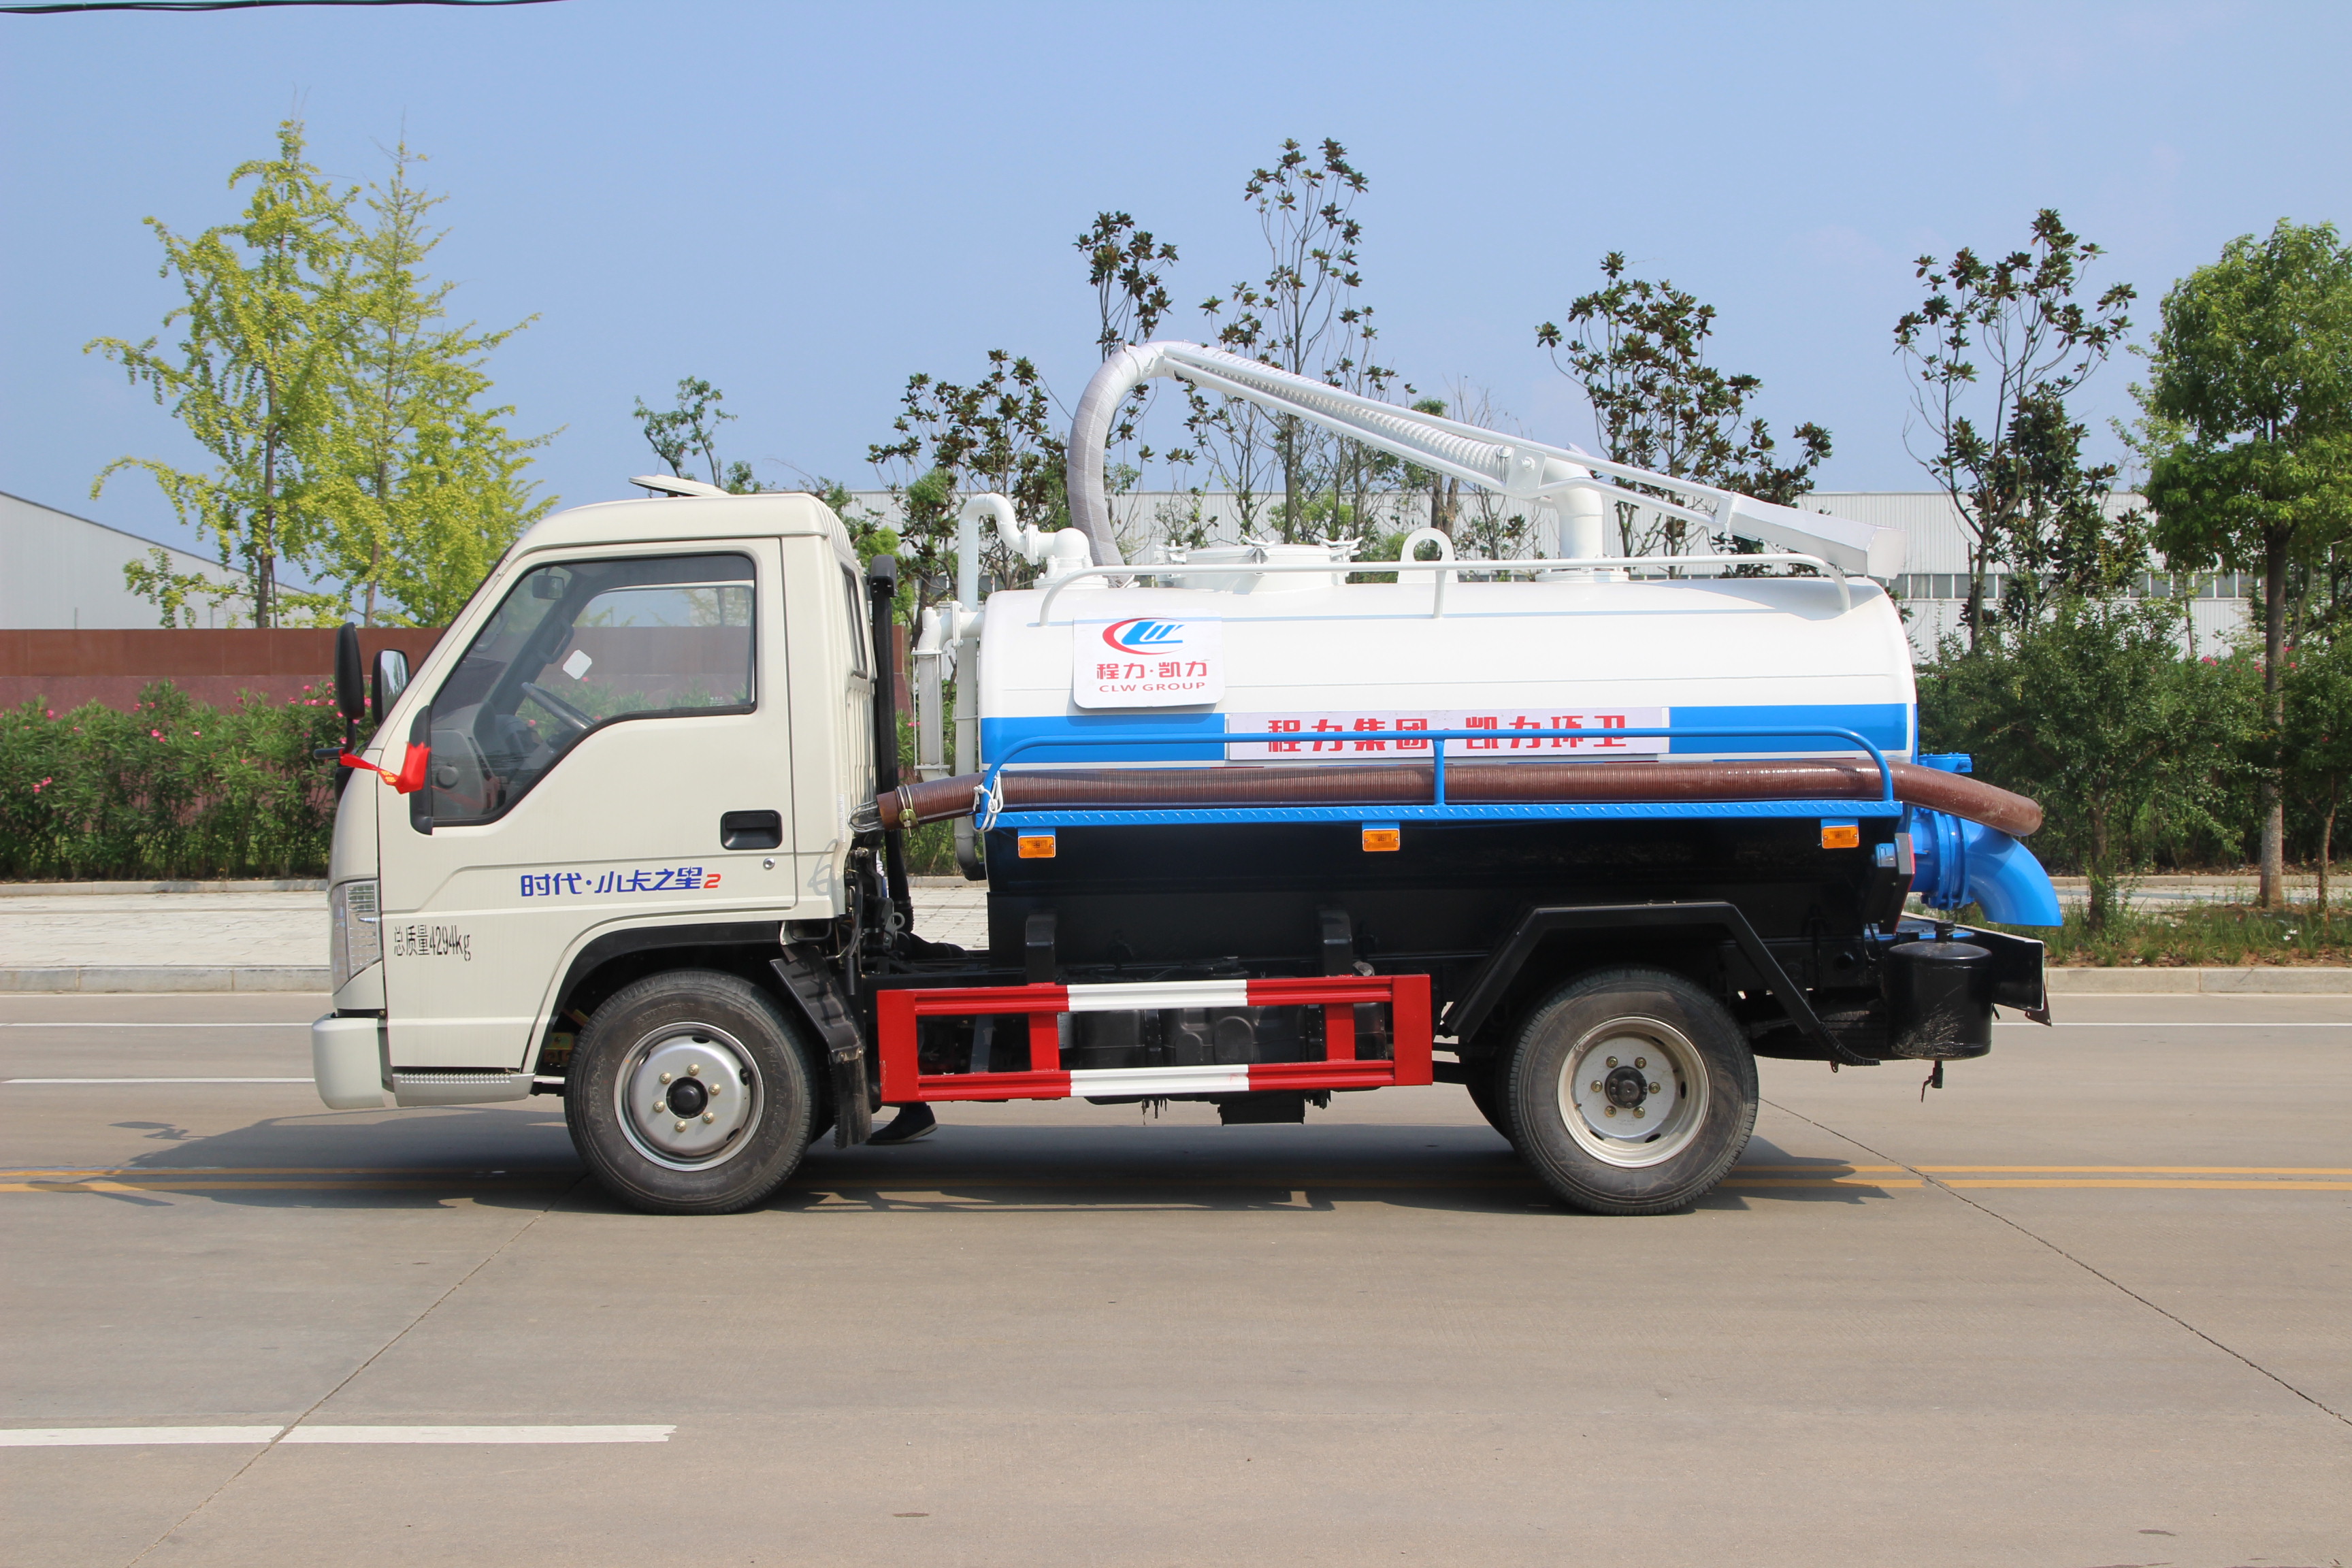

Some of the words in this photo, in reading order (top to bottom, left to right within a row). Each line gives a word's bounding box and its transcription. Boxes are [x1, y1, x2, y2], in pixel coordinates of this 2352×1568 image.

[1096, 661, 1207, 679] 程力·凯力
[1099, 684, 1137, 692] CLW
[1142, 683, 1205, 691] GROUP
